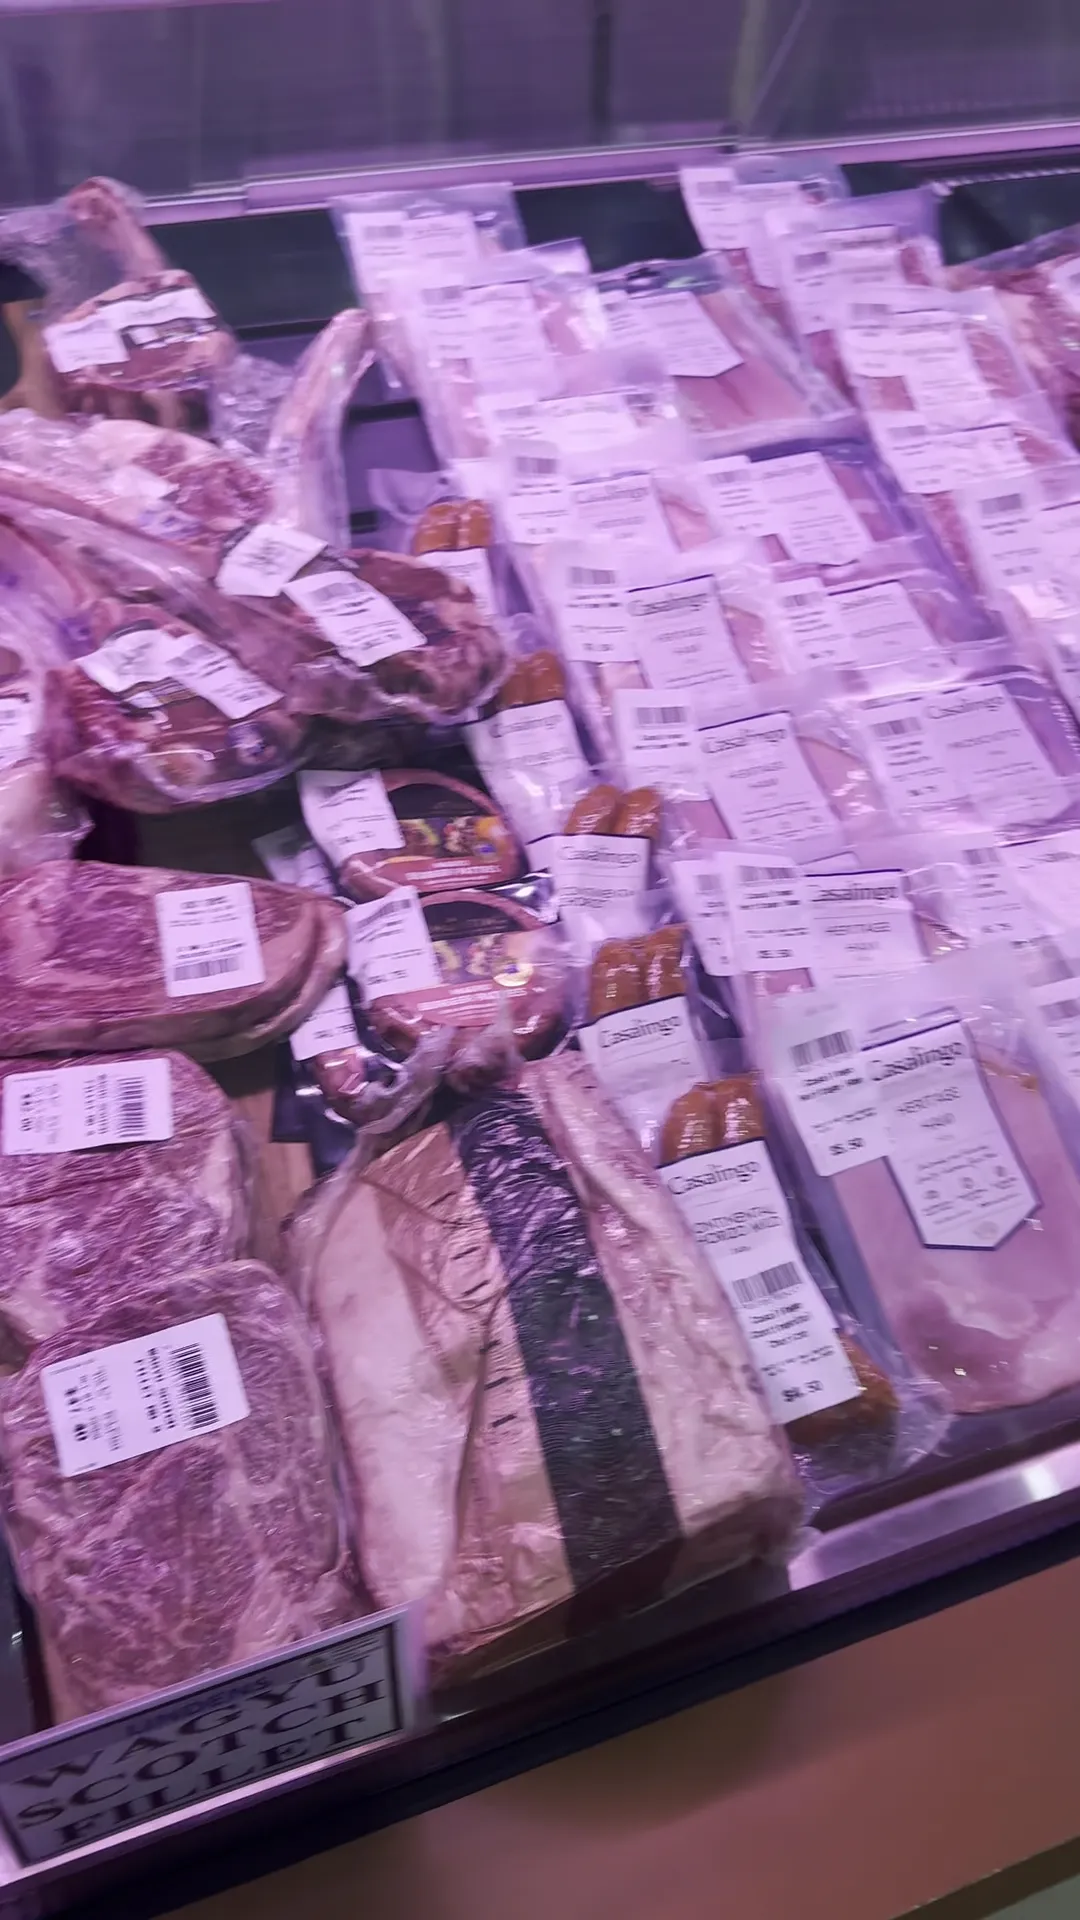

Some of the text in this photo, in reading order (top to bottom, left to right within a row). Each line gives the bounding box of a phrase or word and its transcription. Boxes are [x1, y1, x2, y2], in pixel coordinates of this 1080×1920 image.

[601, 1014, 682, 1048] Casalingo
[866, 1042, 964, 1083] Casalingo
[667, 1160, 761, 1196] Casalingo
[694, 1206, 777, 1234] ONTINENTAL
[12, 1658, 368, 1790] WAGYU
[16, 1679, 386, 1830] SCOTCH
[56, 1716, 367, 1846] FILLET
